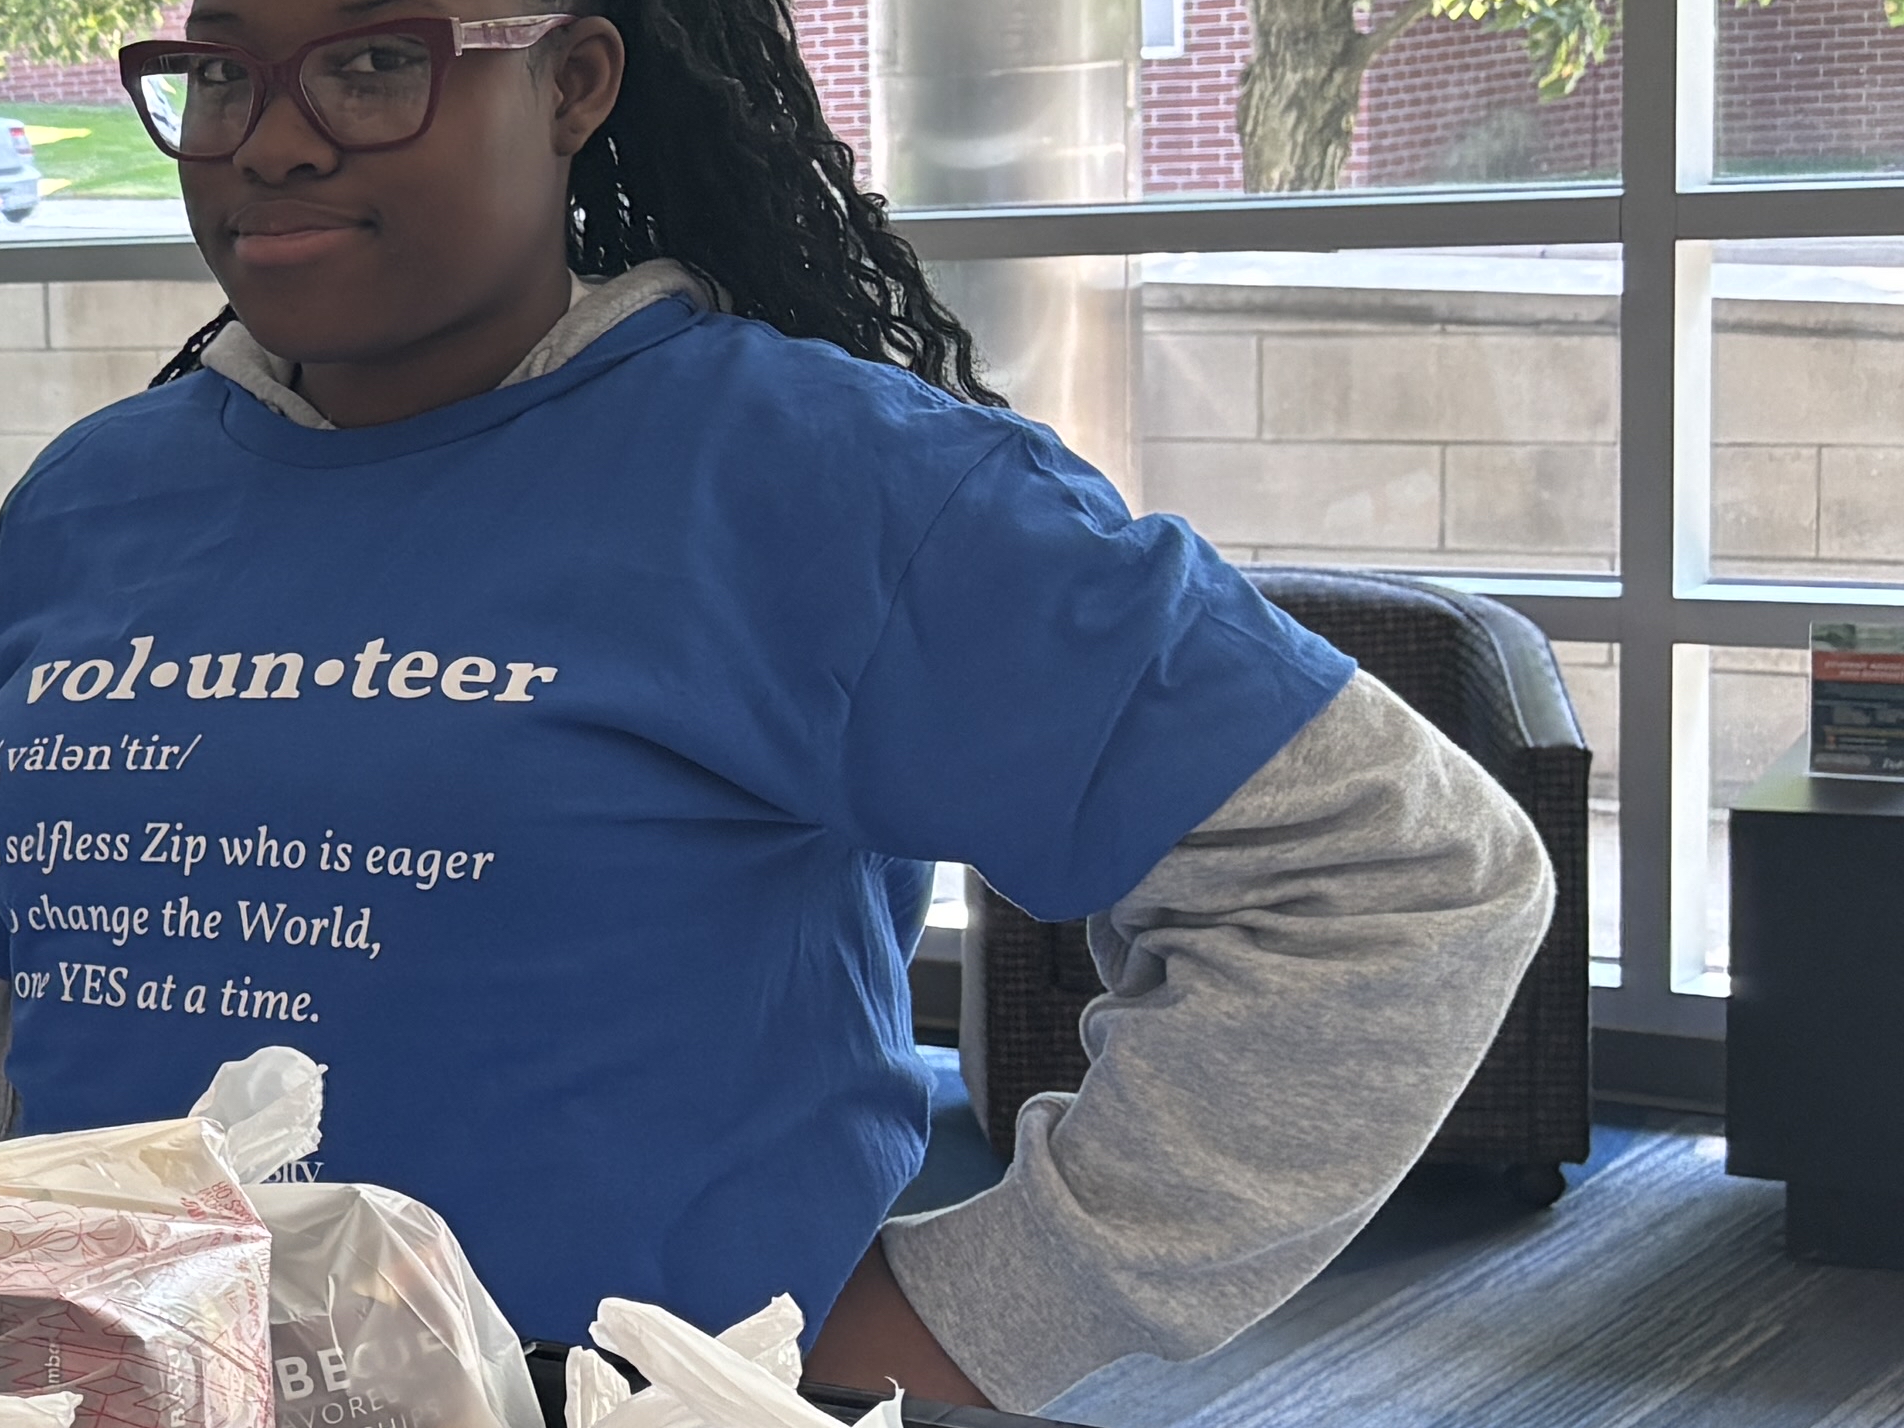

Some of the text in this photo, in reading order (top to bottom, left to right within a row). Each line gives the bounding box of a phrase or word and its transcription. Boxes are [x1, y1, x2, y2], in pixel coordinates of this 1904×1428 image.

[6, 821, 130, 875] selfless
[140, 822, 207, 876] Zip
[219, 825, 306, 871] who
[319, 829, 351, 873] is
[366, 845, 495, 889] eager
[28, 894, 150, 947] change
[162, 896, 222, 939] the
[237, 899, 382, 958] World,
[59, 962, 129, 1007] YES
[137, 975, 176, 1012] at
[184, 985, 207, 1014] a
[221, 975, 320, 1022] time.
